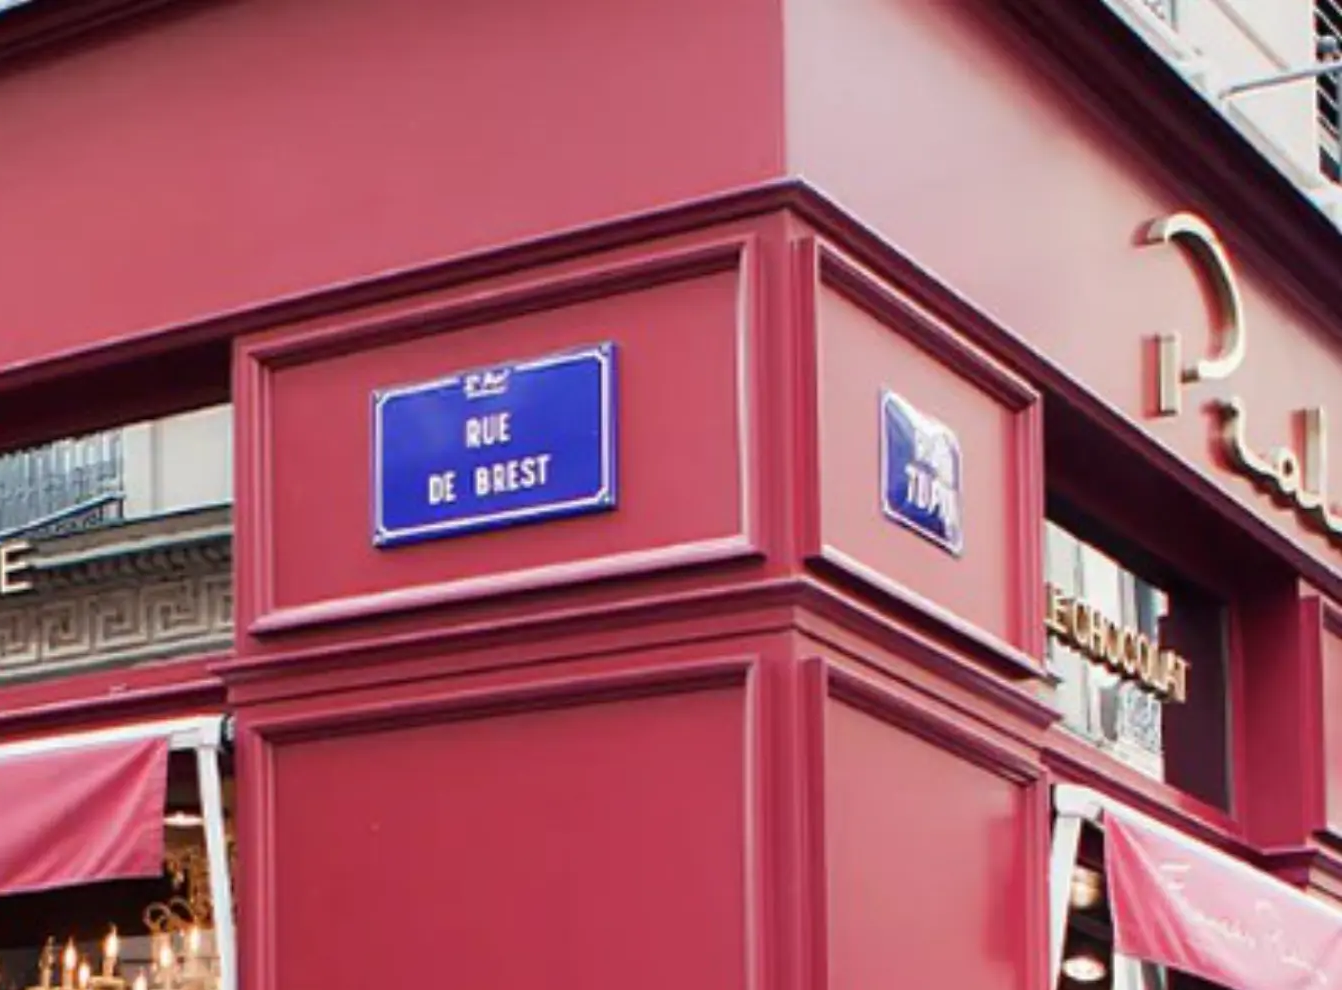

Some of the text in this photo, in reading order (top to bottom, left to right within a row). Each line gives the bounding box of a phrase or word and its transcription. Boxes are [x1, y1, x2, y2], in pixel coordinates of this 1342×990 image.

[465, 412, 512, 449] RUE
[427, 453, 552, 506] DE BREST
